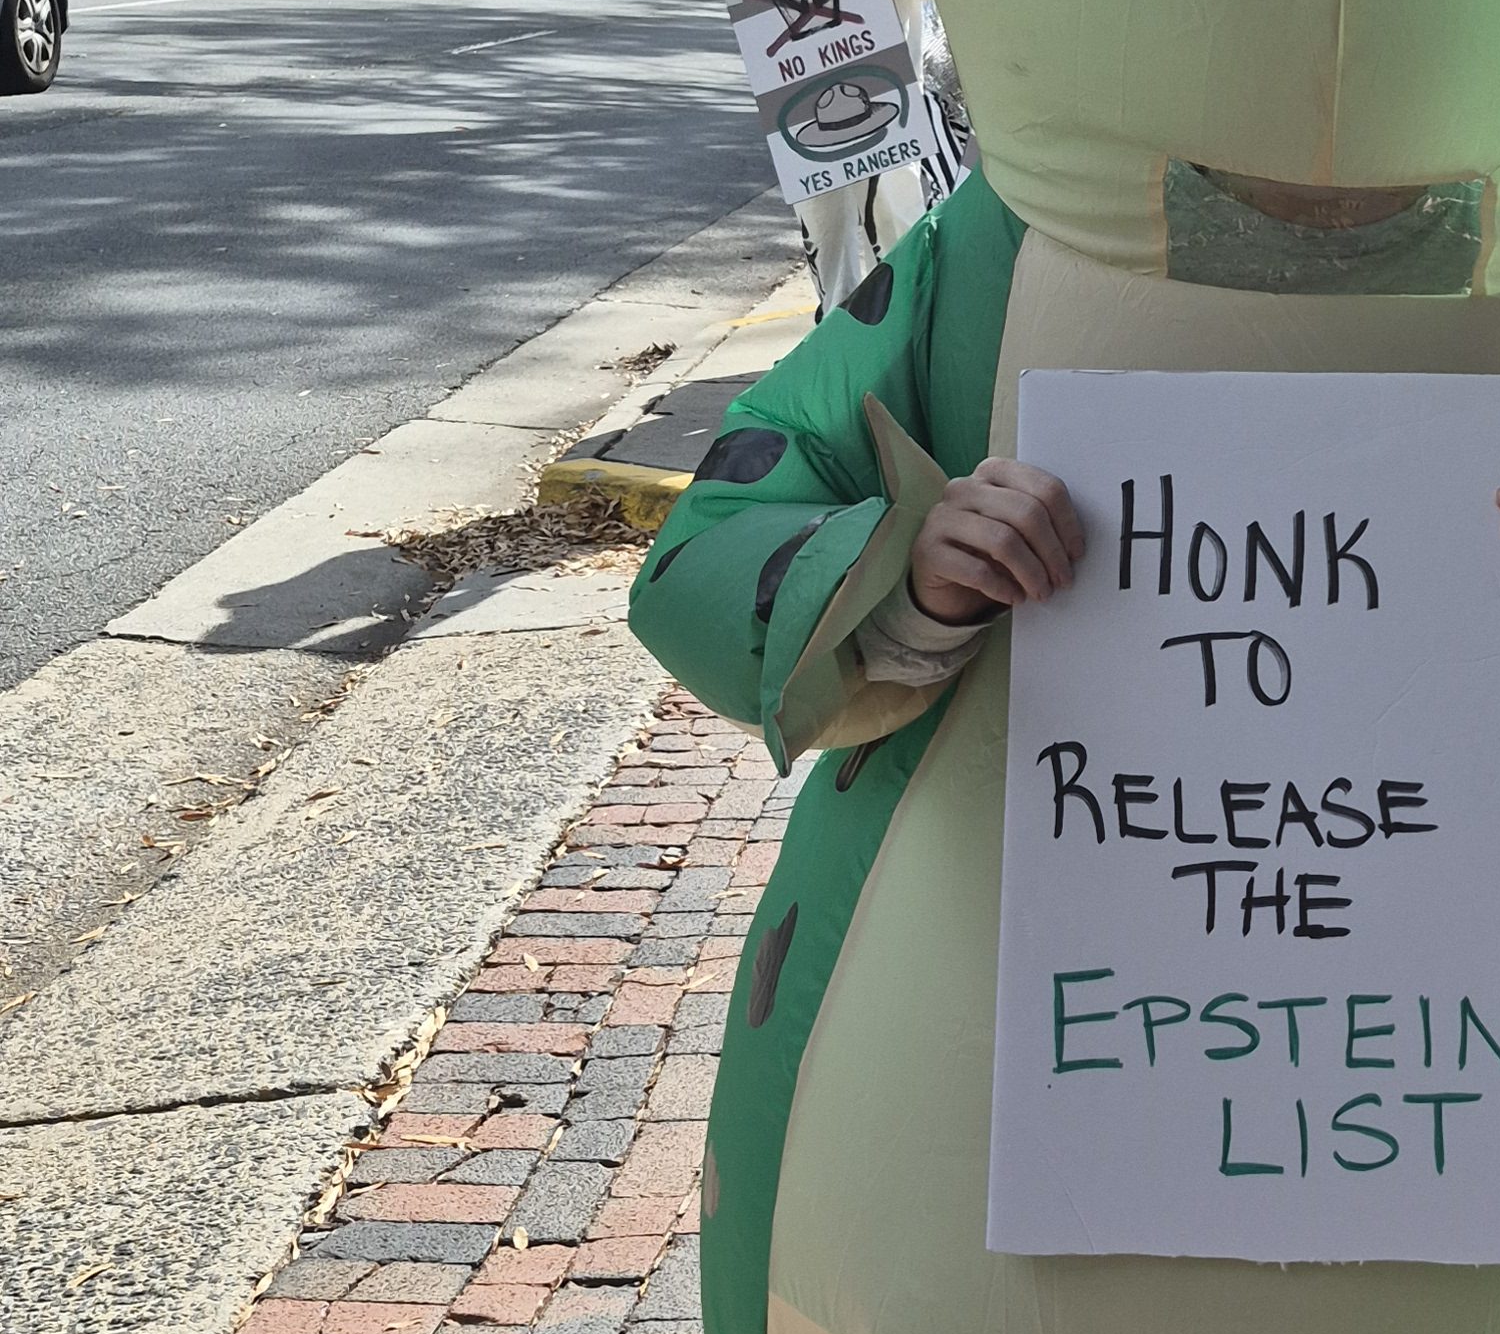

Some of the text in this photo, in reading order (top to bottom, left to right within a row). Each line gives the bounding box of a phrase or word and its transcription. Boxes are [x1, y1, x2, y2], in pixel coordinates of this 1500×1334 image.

[778, 30, 876, 83] NO KINGS
[799, 138, 922, 196] YES RANGERS
[1118, 473, 1381, 612] HONK
[1160, 629, 1294, 708] TO
[1036, 741, 1439, 849] RELEASE
[1171, 860, 1353, 940] THE
[1218, 1092, 1483, 1179] LIST
